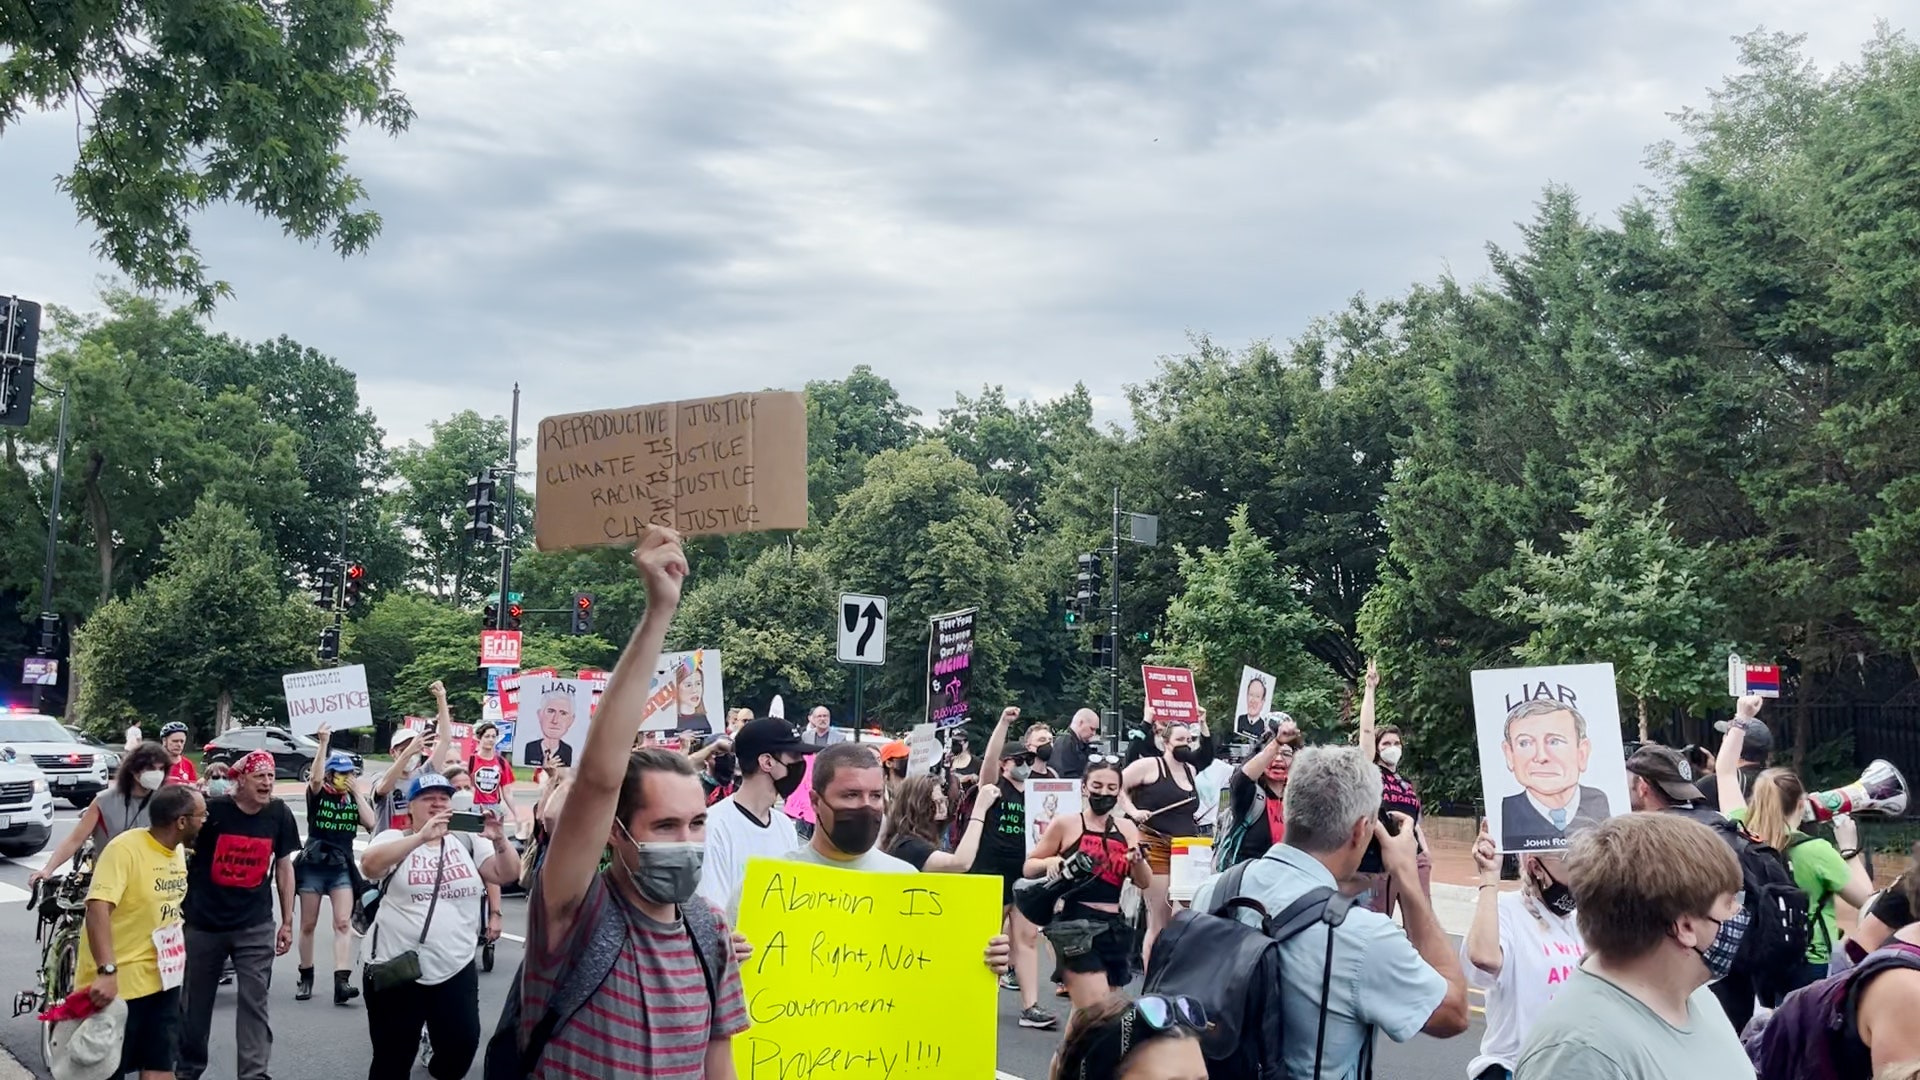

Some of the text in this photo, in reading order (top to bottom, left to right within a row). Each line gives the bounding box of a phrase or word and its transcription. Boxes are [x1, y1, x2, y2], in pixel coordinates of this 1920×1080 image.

[542, 398, 760, 452] REPRODUCTIVE JUSTICE
[643, 437, 673, 455] IS
[546, 436, 745, 486] CLIMATE JUSTICE
[591, 465, 755, 508] RACIAL JUSTICE
[646, 470, 670, 487] IS
[650, 499, 674, 513] IS
[603, 504, 761, 540] CLASS JUSTICE
[483, 634, 519, 650] Erin
[483, 649, 518, 660] PALMER
[541, 682, 577, 695] LIAR
[1505, 681, 1578, 713] LIAR
[289, 691, 370, 718] INJUSTICE
[1007, 802, 1025, 813] WIL
[1000, 814, 1019, 824] AND
[1523, 839, 1550, 848] JOHN
[440, 887, 478, 899] PEOPLE
[760, 873, 874, 915] Abortion
[758, 930, 932, 978] A Right, Not
[749, 987, 896, 1024] Government
